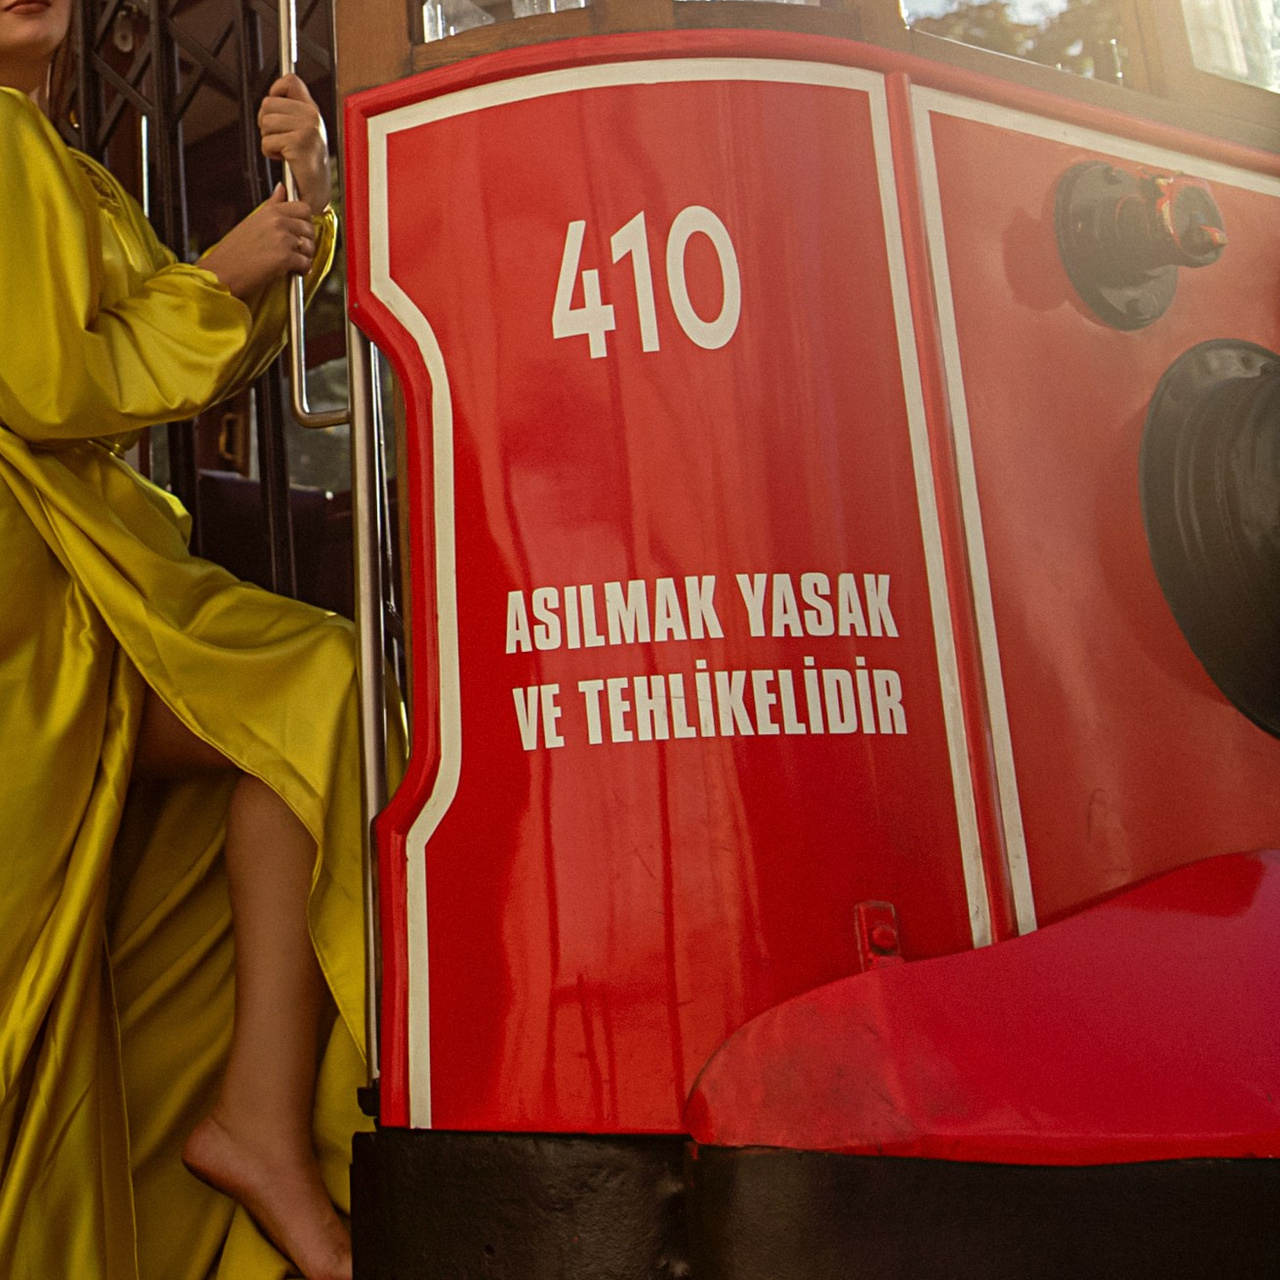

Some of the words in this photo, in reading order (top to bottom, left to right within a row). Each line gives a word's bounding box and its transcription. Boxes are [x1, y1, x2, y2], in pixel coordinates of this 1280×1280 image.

[551, 205, 742, 359] 410
[505, 575, 725, 654] ASILMAK
[735, 572, 899, 638] YASAK
[512, 683, 565, 751] VE
[577, 656, 907, 745] TEHLİKELİDİR
